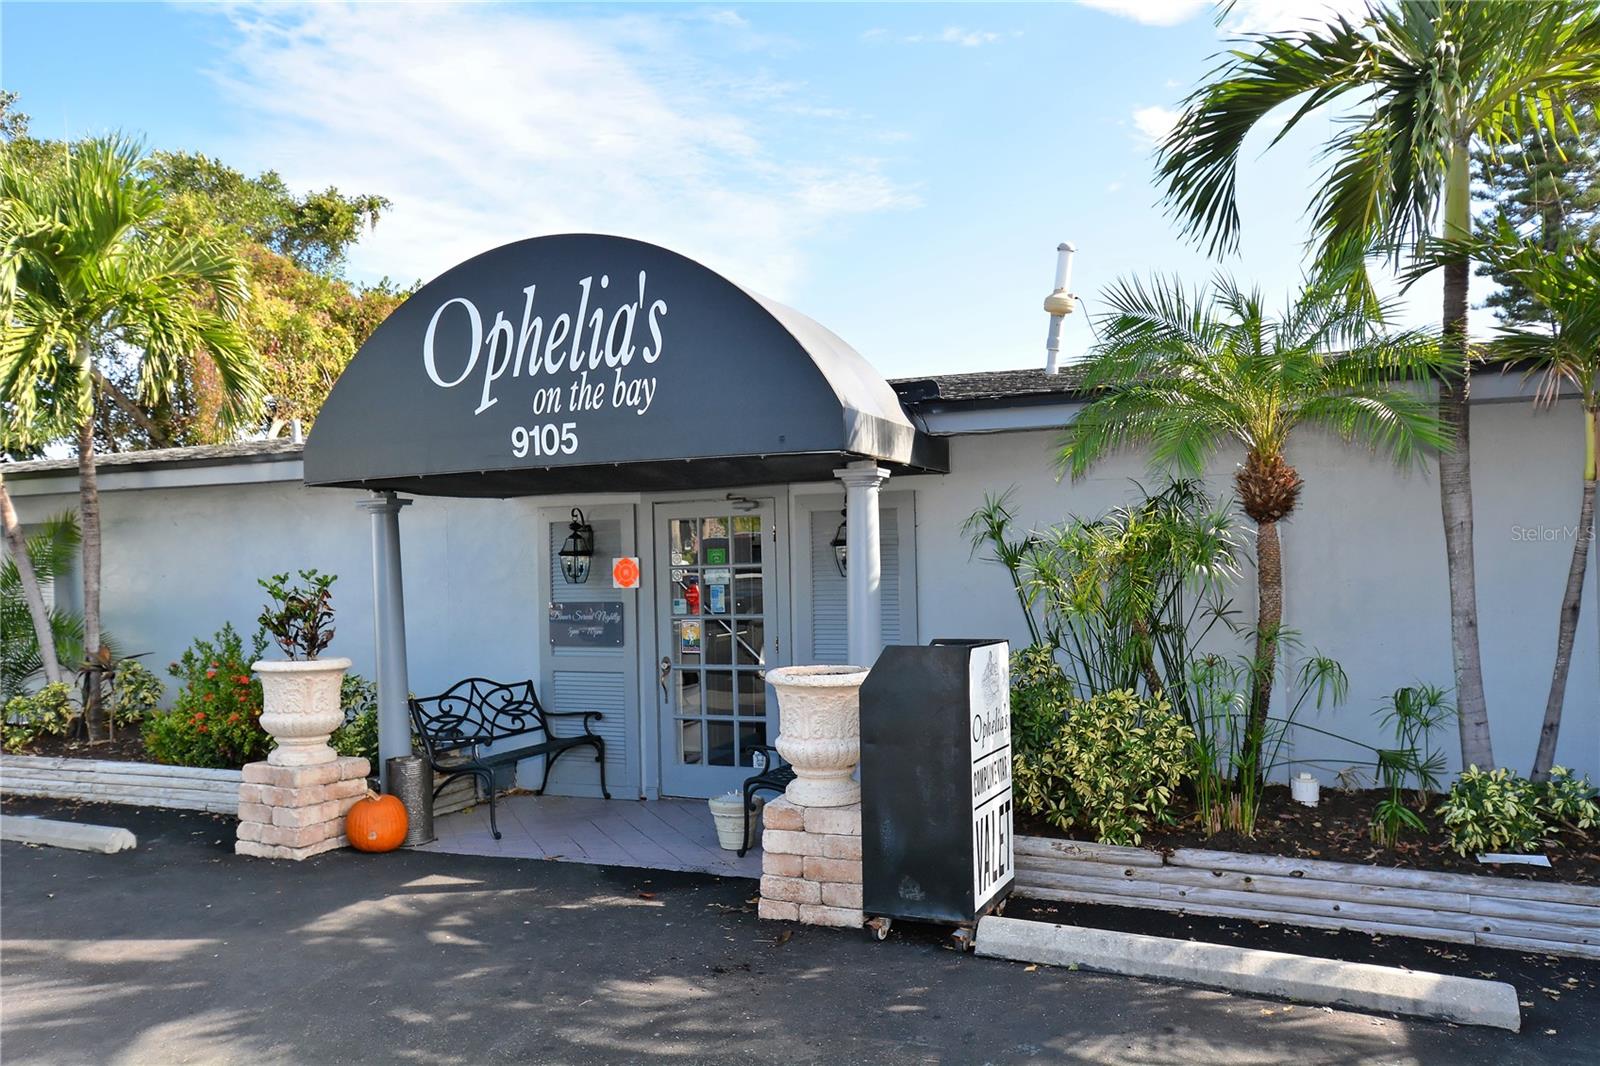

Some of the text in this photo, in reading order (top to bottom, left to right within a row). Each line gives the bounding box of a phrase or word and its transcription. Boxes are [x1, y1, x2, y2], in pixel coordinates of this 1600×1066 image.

[423, 270, 668, 416] Ophelia's
[532, 367, 657, 416] on the bay
[511, 422, 579, 458] 9105
[972, 703, 1009, 750] Ophelia's
[975, 799, 1011, 897] VALET
